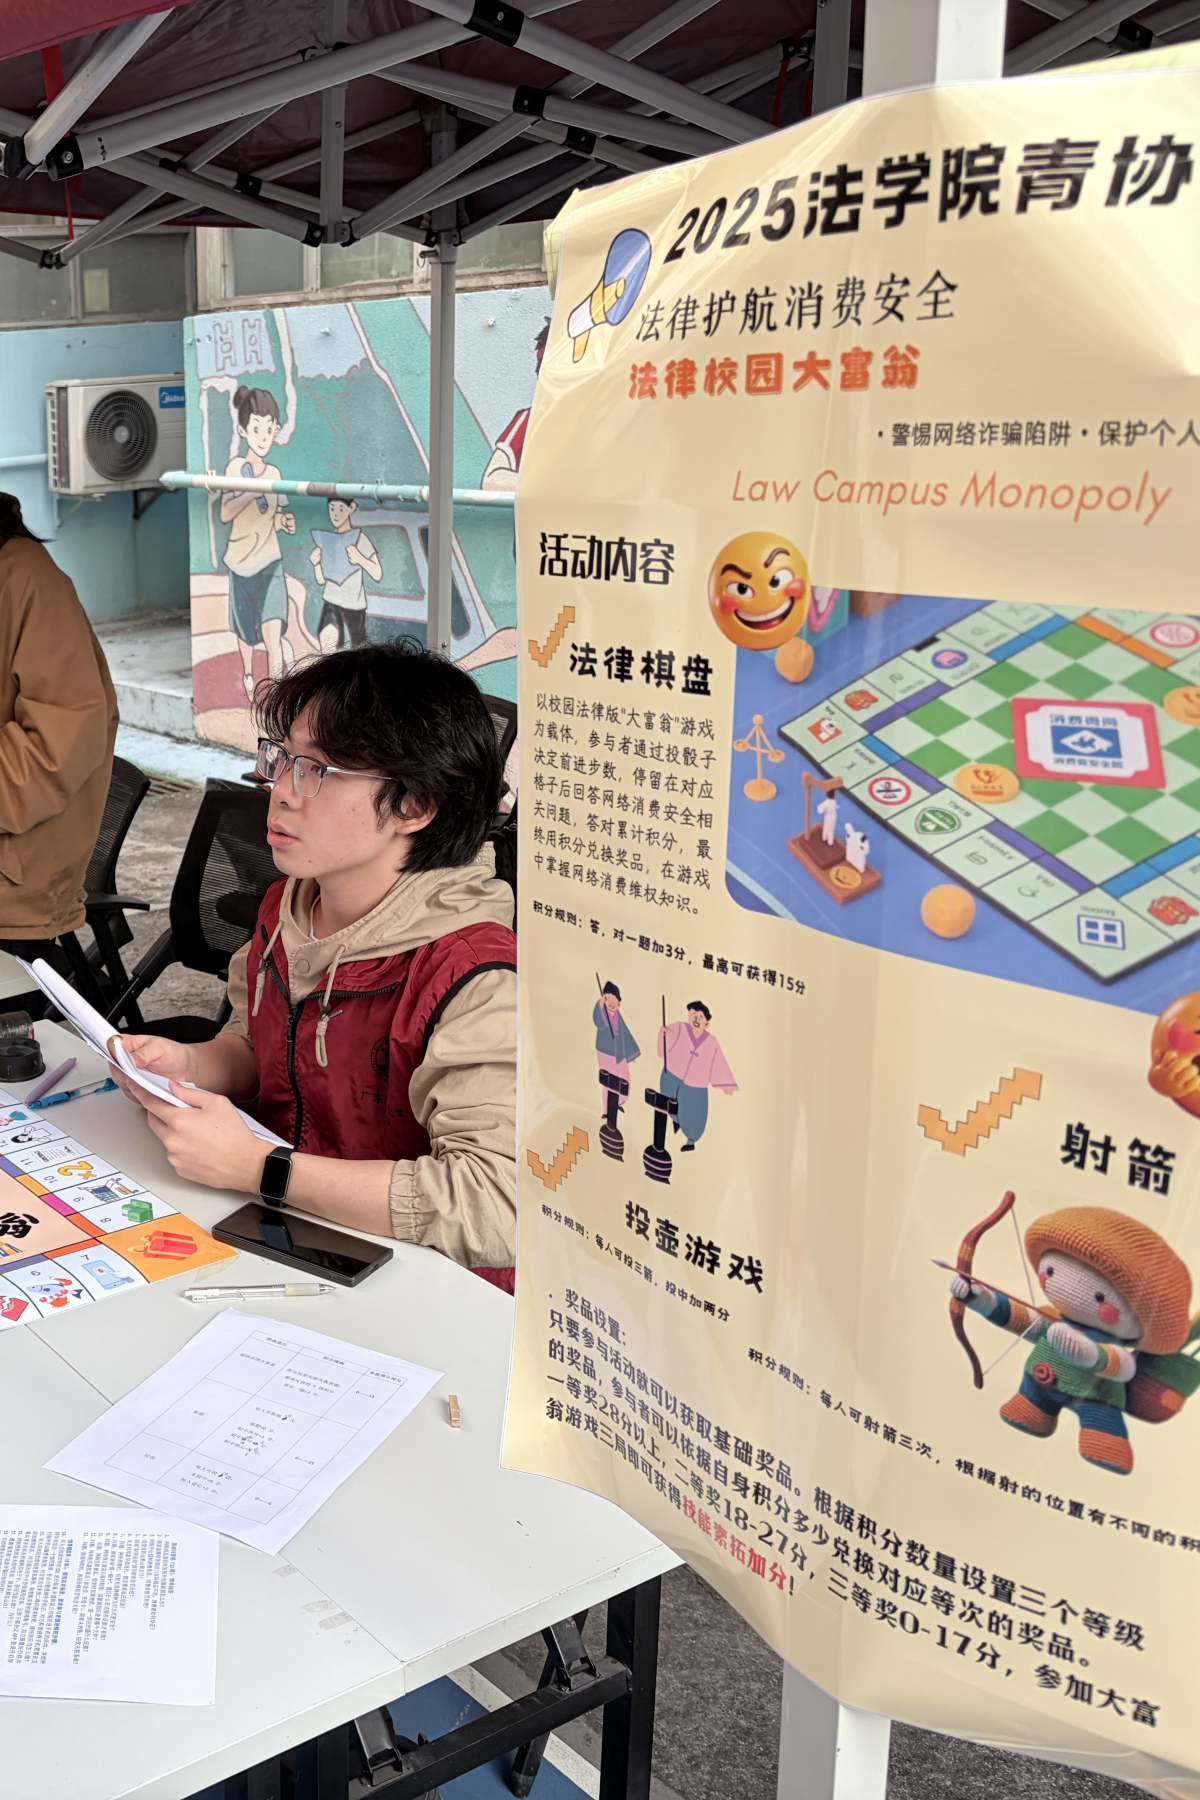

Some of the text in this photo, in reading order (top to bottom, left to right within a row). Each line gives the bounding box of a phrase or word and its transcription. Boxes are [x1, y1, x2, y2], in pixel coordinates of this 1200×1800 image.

[662, 133, 1196, 265] 2025法学院青协
[633, 268, 959, 344] 法律护航消费安全
[628, 344, 922, 400] 法律校园大富翁
[731, 468, 1173, 526] Law Campus Monopoly
[539, 531, 675, 586] 活动内容
[569, 642, 714, 697] 法律棋盘
[533, 772, 714, 830] 格子后回答网络消费安全相
[1060, 1121, 1177, 1197] 射箭
[625, 1200, 765, 1294] 投壶游戏
